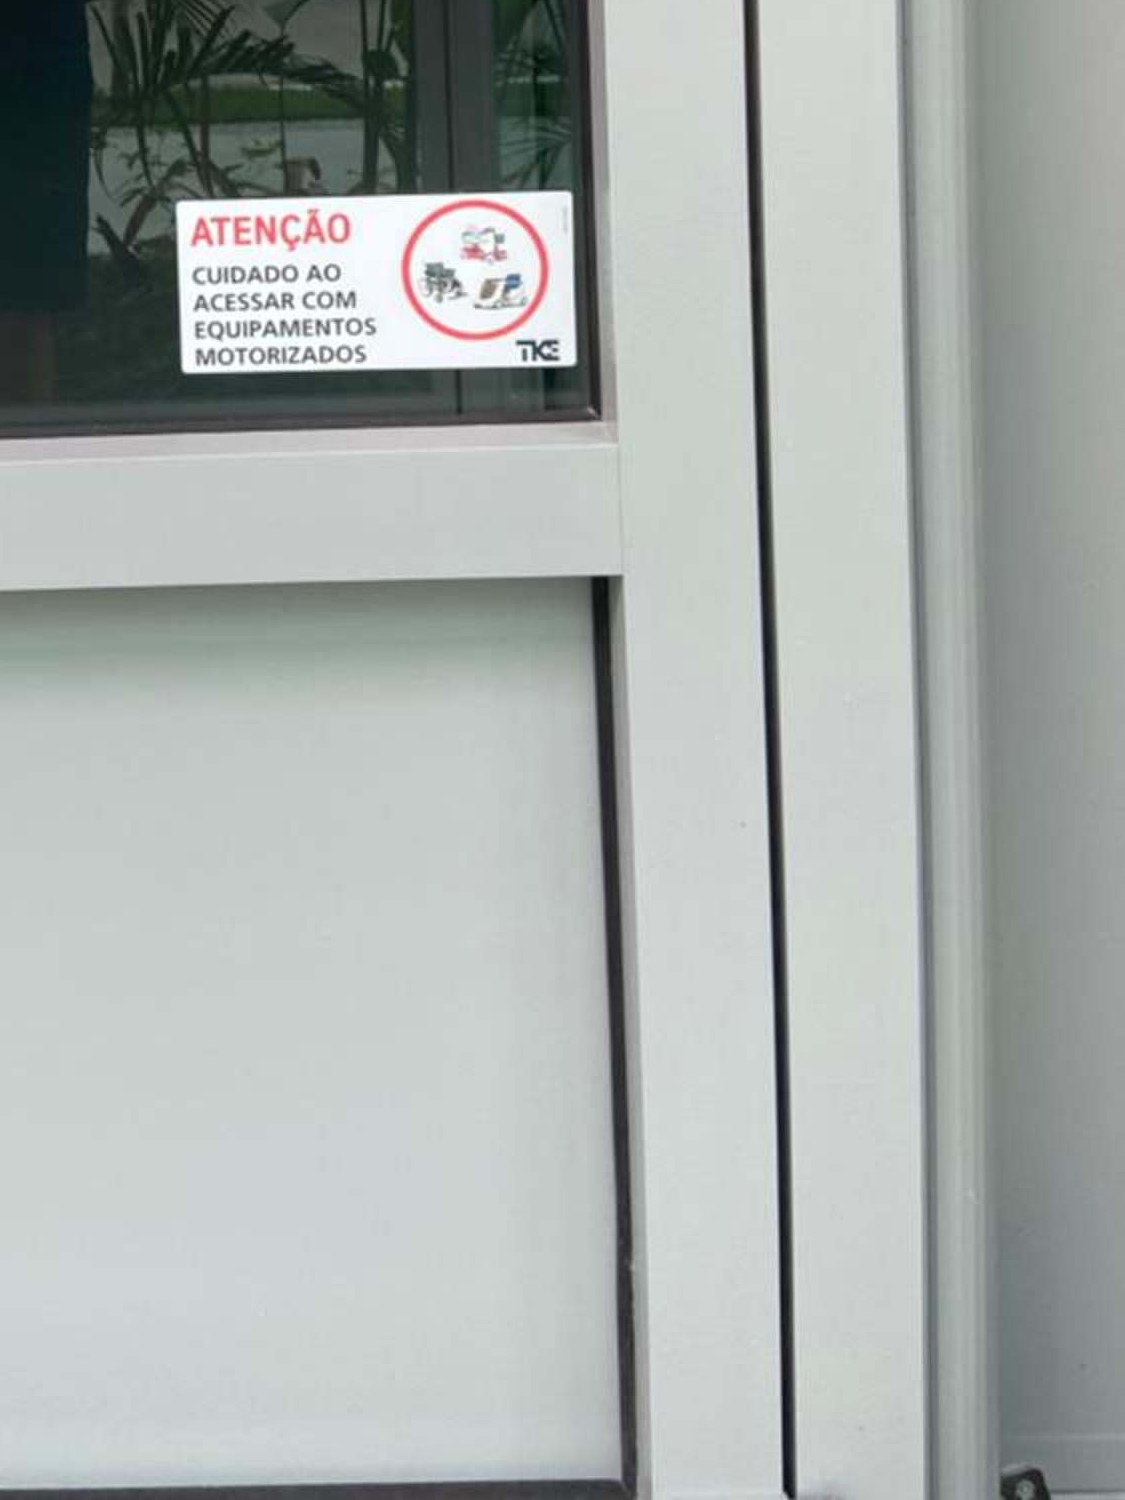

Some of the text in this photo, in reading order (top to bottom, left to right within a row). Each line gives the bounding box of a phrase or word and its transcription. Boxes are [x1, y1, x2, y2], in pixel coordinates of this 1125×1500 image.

[190, 209, 351, 251] ATENÇÃO
[192, 263, 342, 285] CUIDADO AO
[193, 290, 357, 312] ACESSAR COM
[195, 317, 377, 342] EQUIPAMENTOS
[195, 345, 367, 367] MOTORIZADOS
[515, 339, 560, 362] TKE
